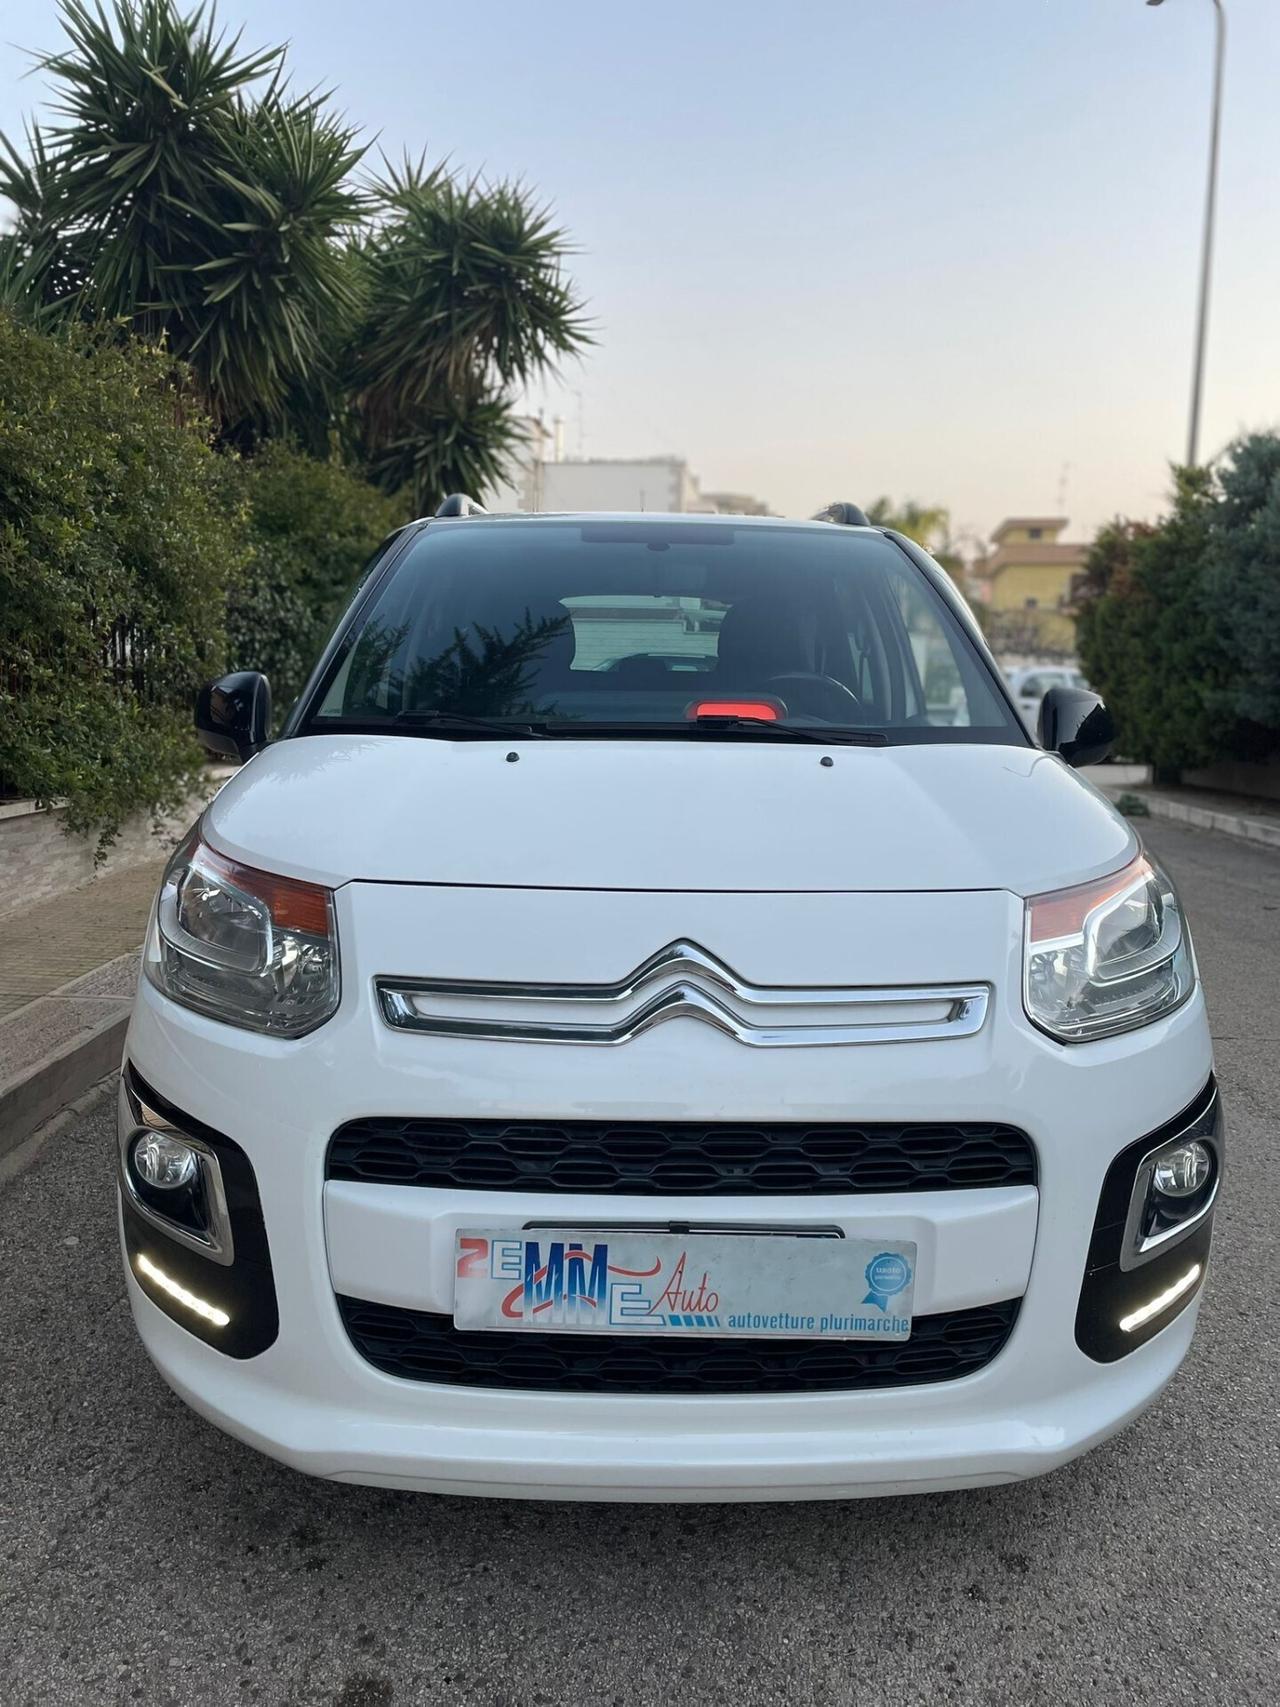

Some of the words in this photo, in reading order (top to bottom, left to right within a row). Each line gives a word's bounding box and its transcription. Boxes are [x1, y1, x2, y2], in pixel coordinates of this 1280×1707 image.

[645, 1251, 719, 1313] Auto
[728, 1313, 814, 1330] autovetture
[820, 1314, 910, 1332] plurimarche
